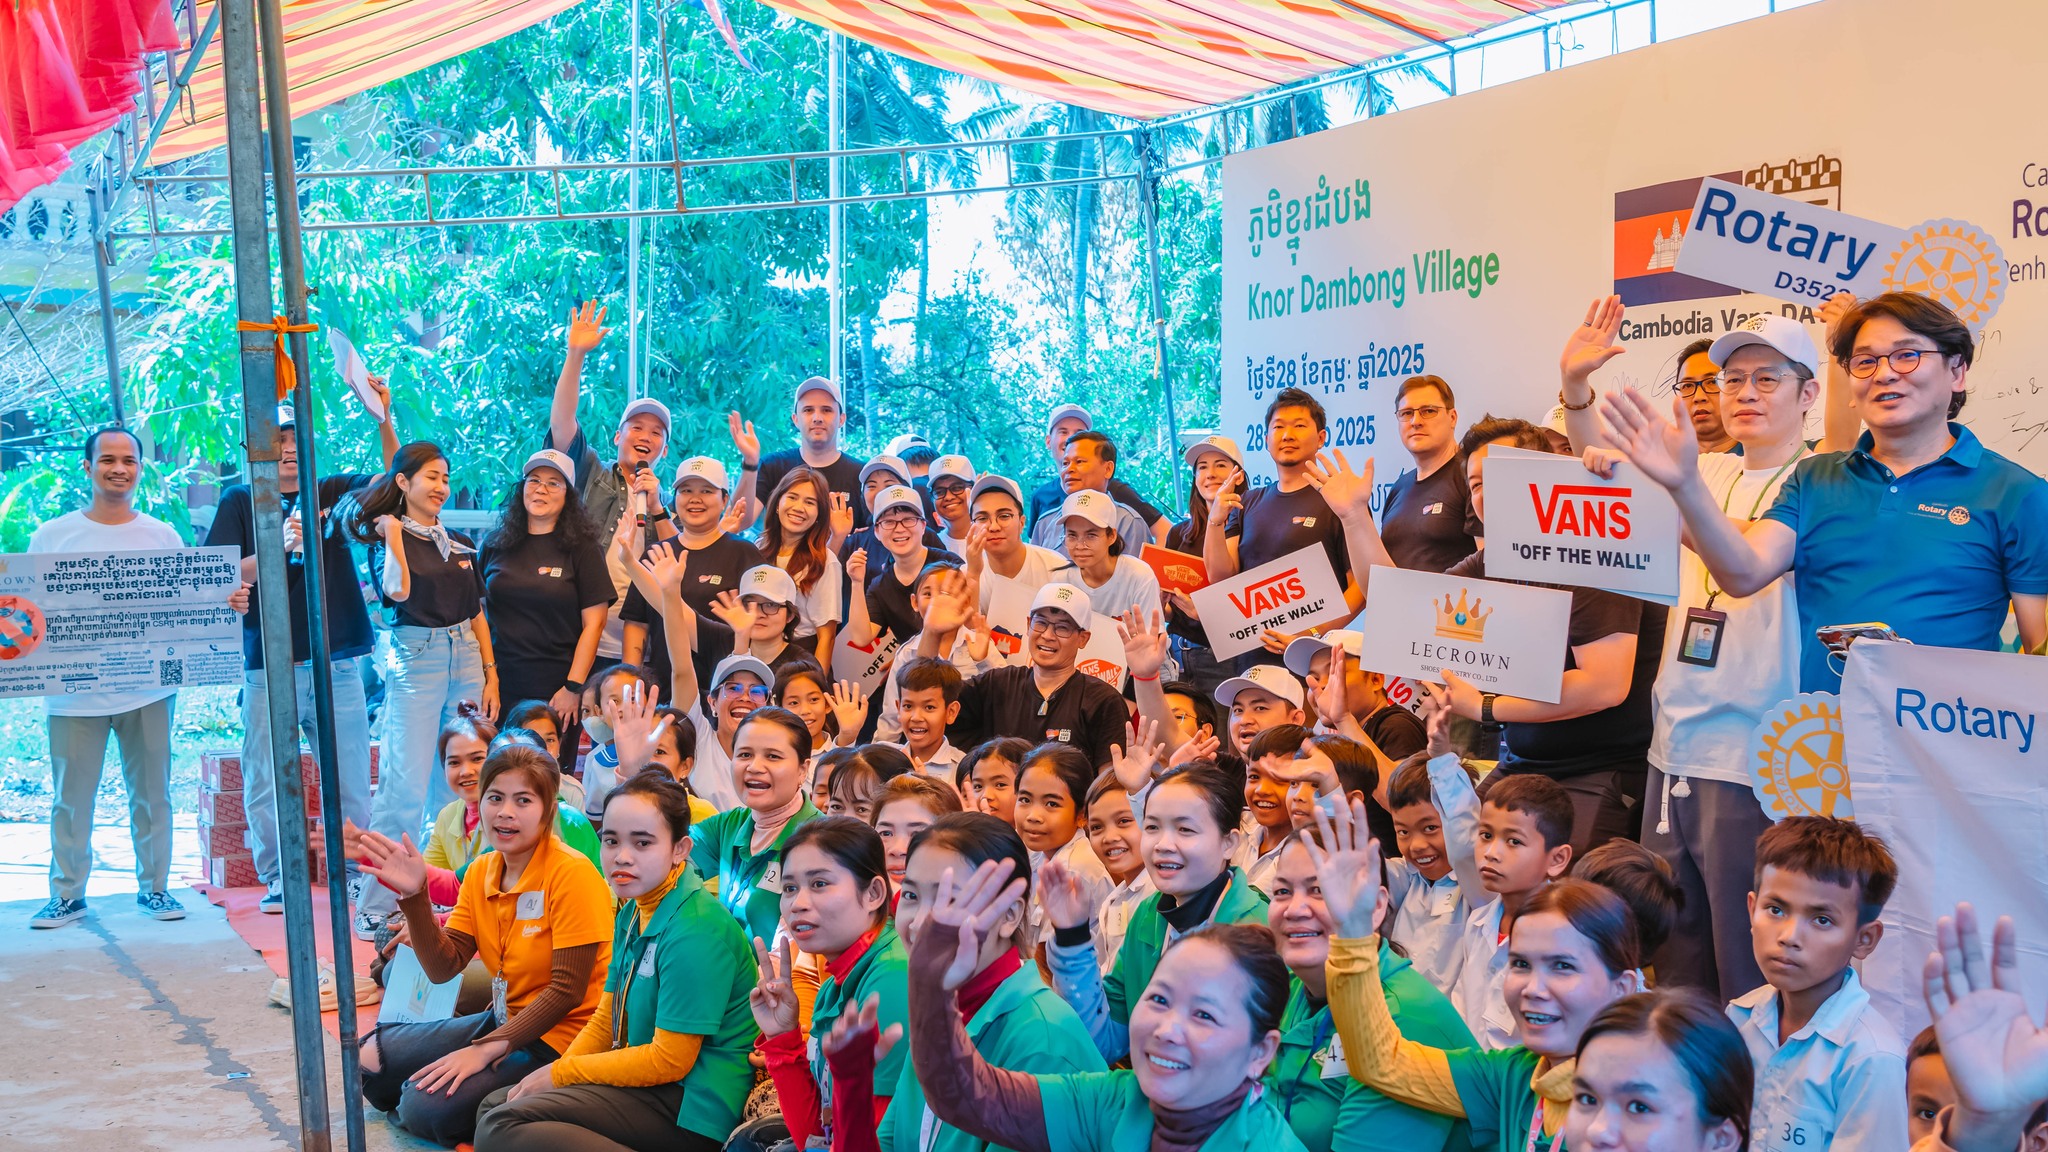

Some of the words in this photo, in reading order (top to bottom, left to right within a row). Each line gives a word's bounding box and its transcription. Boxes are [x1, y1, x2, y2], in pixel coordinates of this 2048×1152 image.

[1695, 187, 1877, 281] Rotary
[1248, 282, 1294, 321] Knor
[1300, 266, 1406, 309] Dambong
[1413, 248, 1500, 299] Village
[1618, 311, 1713, 341] Cambodia
[1335, 415, 1376, 447] 2025
[1528, 483, 1633, 540] VANS
[1918, 503, 1948, 516] Rotary
[1512, 542, 1551, 561] "OFF
[1556, 547, 1591, 565] THE
[1597, 550, 1651, 570] WALL"
[1227, 567, 1306, 619] VANS
[1229, 625, 1259, 641] "OFF
[1260, 614, 1287, 630] THE
[1287, 598, 1325, 621] WALL"
[862, 654, 885, 678] "OFF
[1411, 642, 1511, 670] LECROWN
[1421, 665, 1440, 673] SHOES
[1485, 675, 1498, 683] LTD
[1896, 687, 2035, 753] Rotary
[1781, 1122, 1806, 1146] 36
